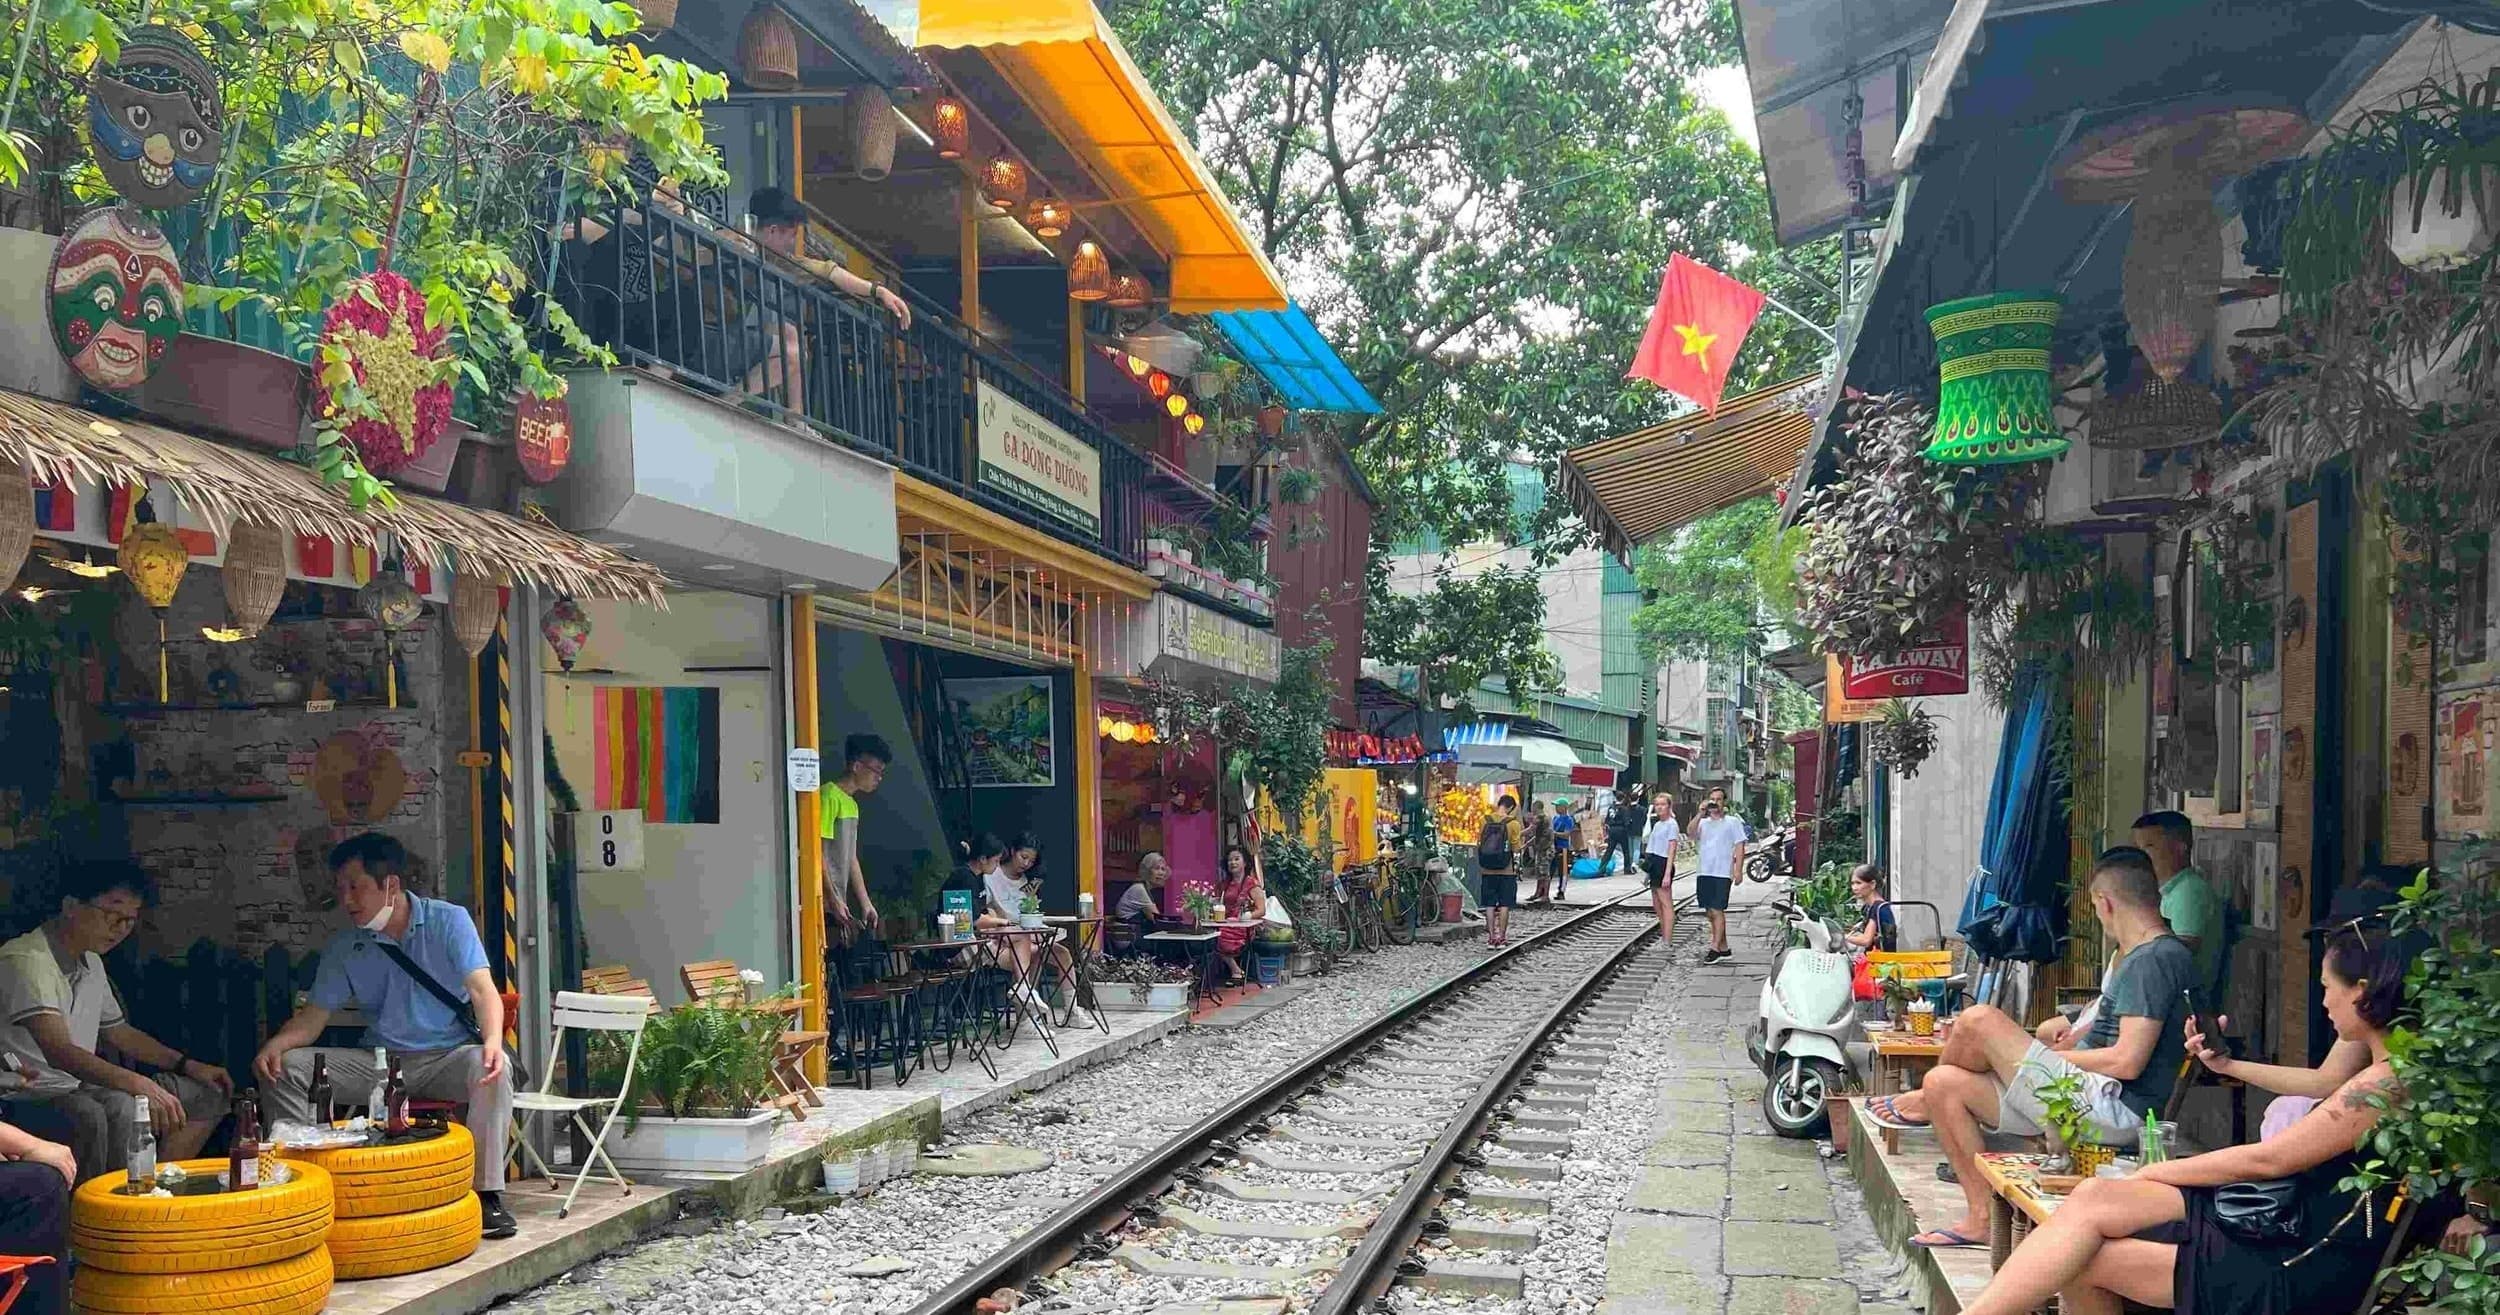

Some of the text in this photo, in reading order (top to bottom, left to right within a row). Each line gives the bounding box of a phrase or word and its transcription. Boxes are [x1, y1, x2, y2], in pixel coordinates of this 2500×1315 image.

[520, 417, 552, 449] BEER
[1003, 431, 1018, 461] GA
[1851, 650, 1963, 677] RALWAY
[1892, 672, 1924, 686] Café
